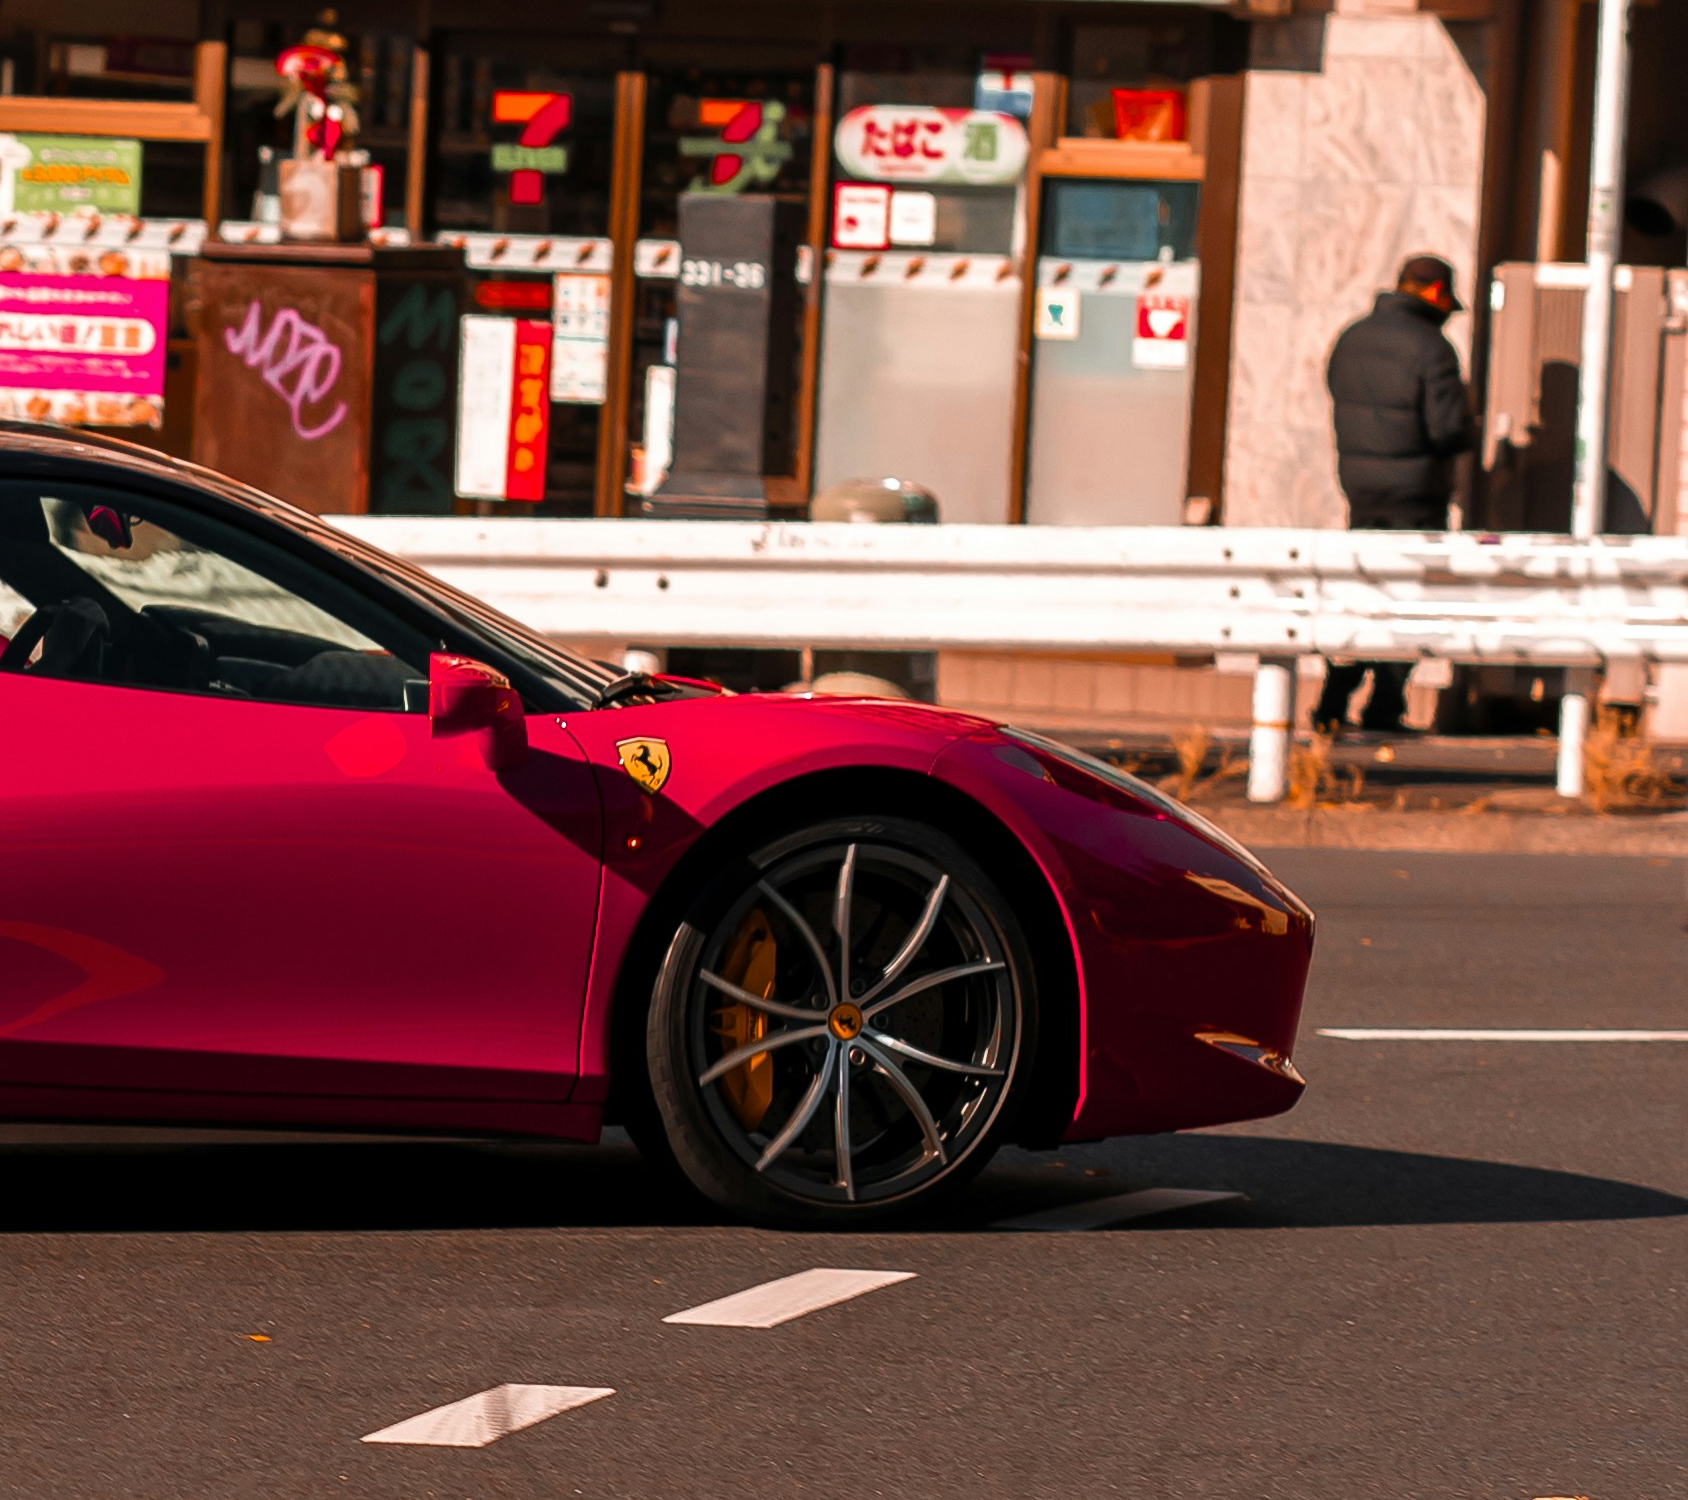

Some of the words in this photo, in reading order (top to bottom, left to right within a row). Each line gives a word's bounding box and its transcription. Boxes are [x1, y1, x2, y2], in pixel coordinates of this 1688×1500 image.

[492, 91, 572, 205] 7
[861, 119, 945, 159] たばこ
[962, 122, 999, 162] 酒
